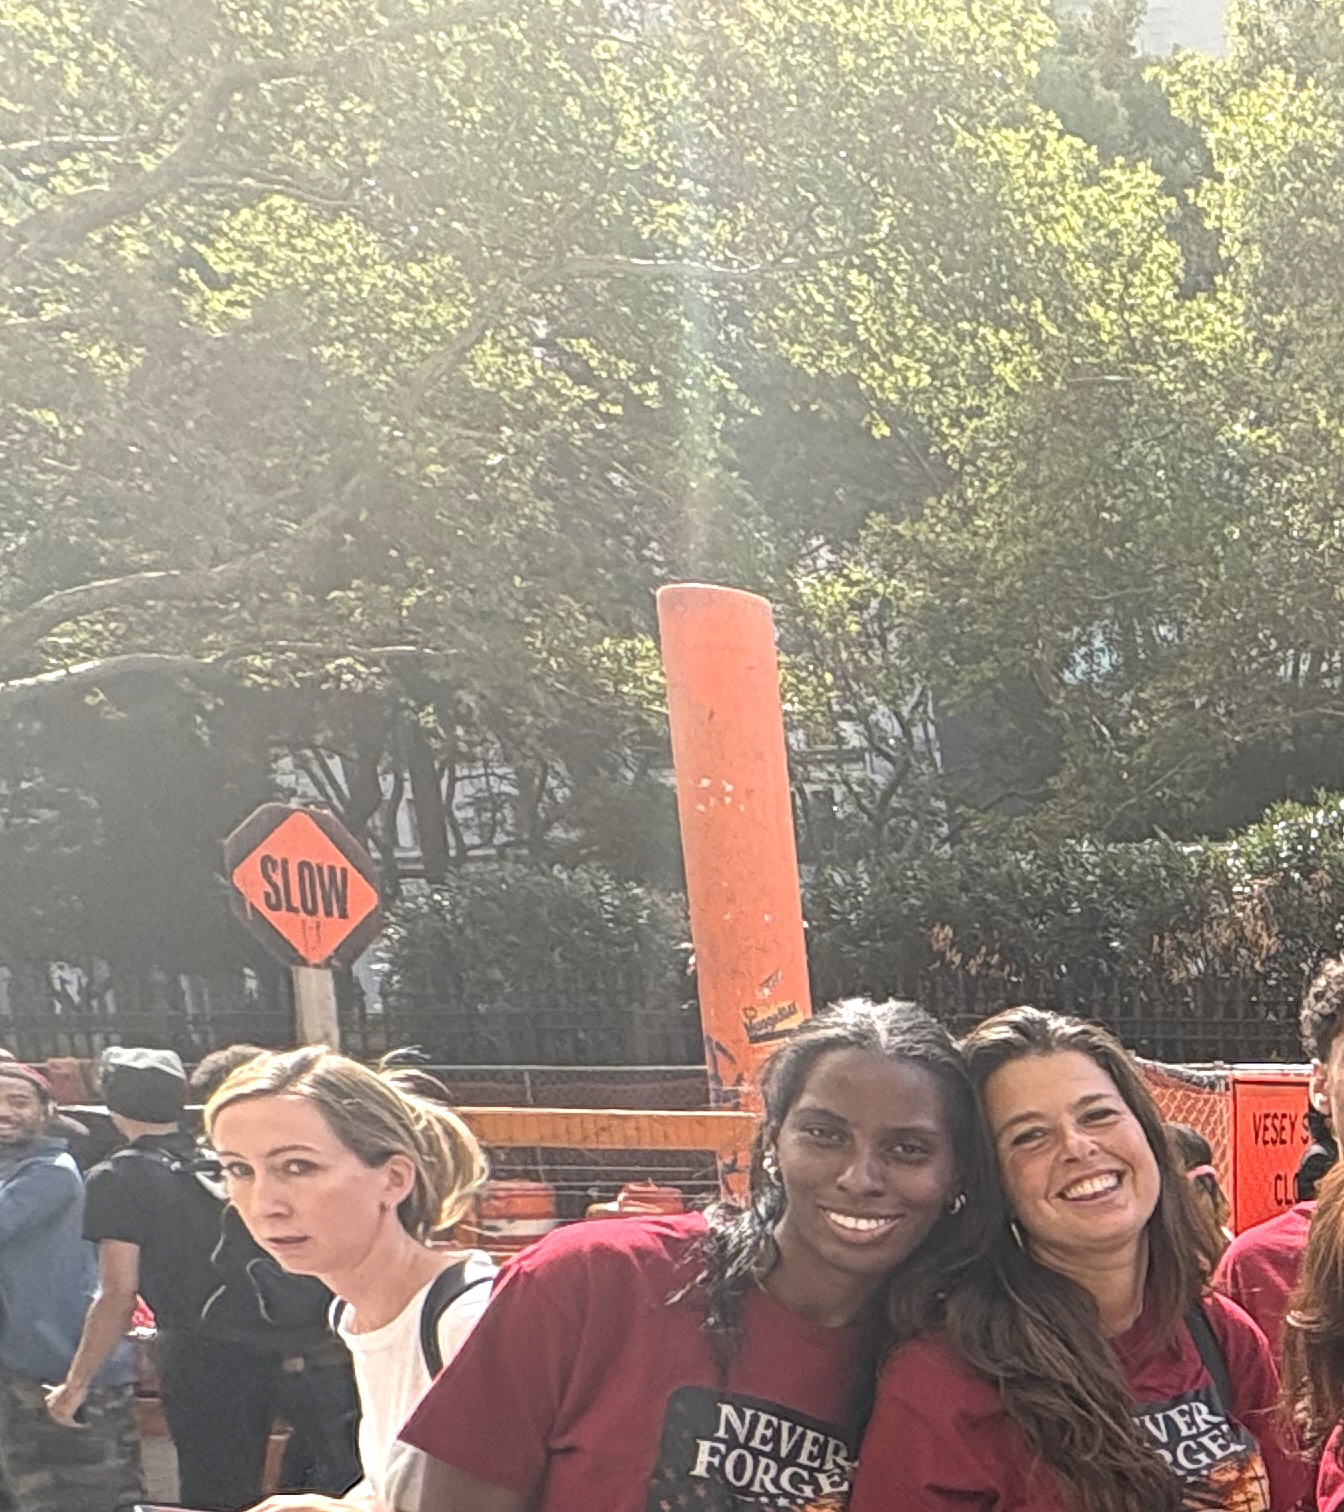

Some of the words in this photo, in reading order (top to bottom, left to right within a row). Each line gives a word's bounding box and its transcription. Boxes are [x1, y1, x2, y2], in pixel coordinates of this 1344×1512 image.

[260, 854, 349, 920] SLOW
[1253, 1112, 1298, 1145] VESEY
[689, 1438, 850, 1499] FORGE
[717, 1402, 859, 1473] NEVER
